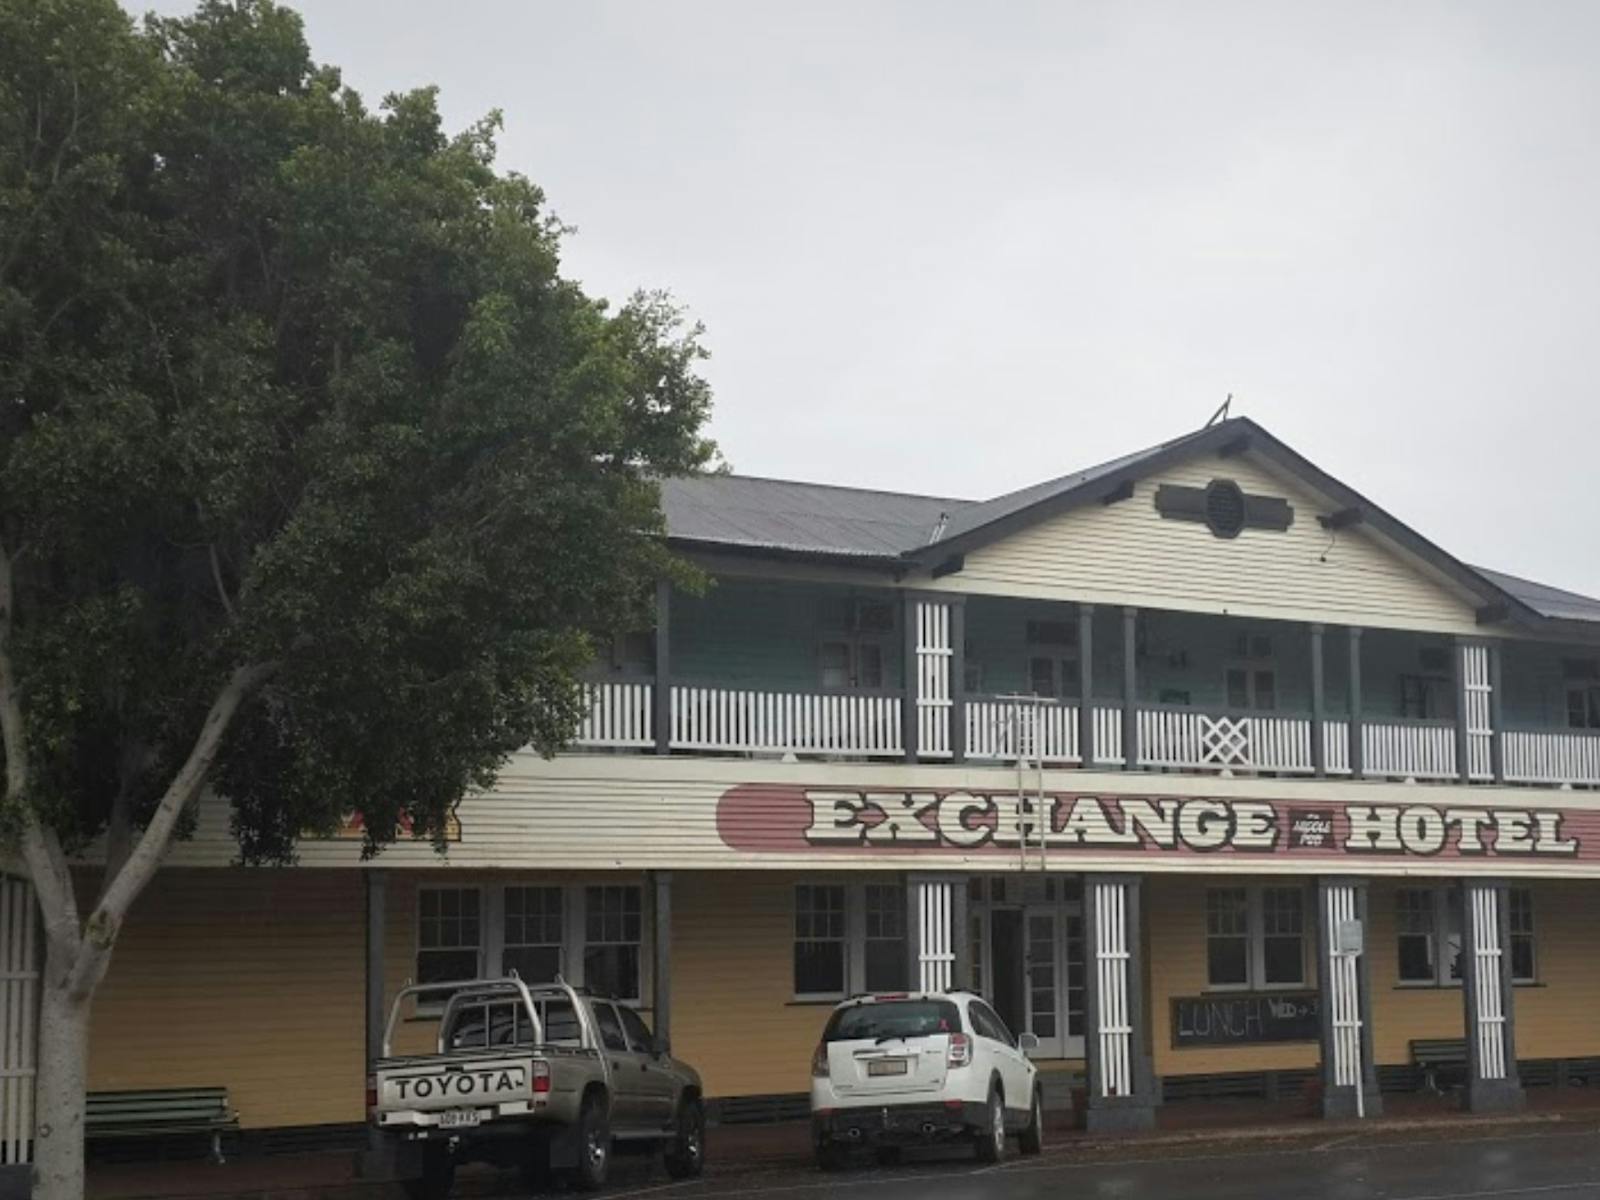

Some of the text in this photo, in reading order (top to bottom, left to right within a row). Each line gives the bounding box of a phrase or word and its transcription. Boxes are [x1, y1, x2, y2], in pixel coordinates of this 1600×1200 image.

[804, 789, 1578, 857] EXCHANGE HOTEL
[1179, 1001, 1263, 1037] LUNCH
[395, 1072, 514, 1099] TOYOTA
